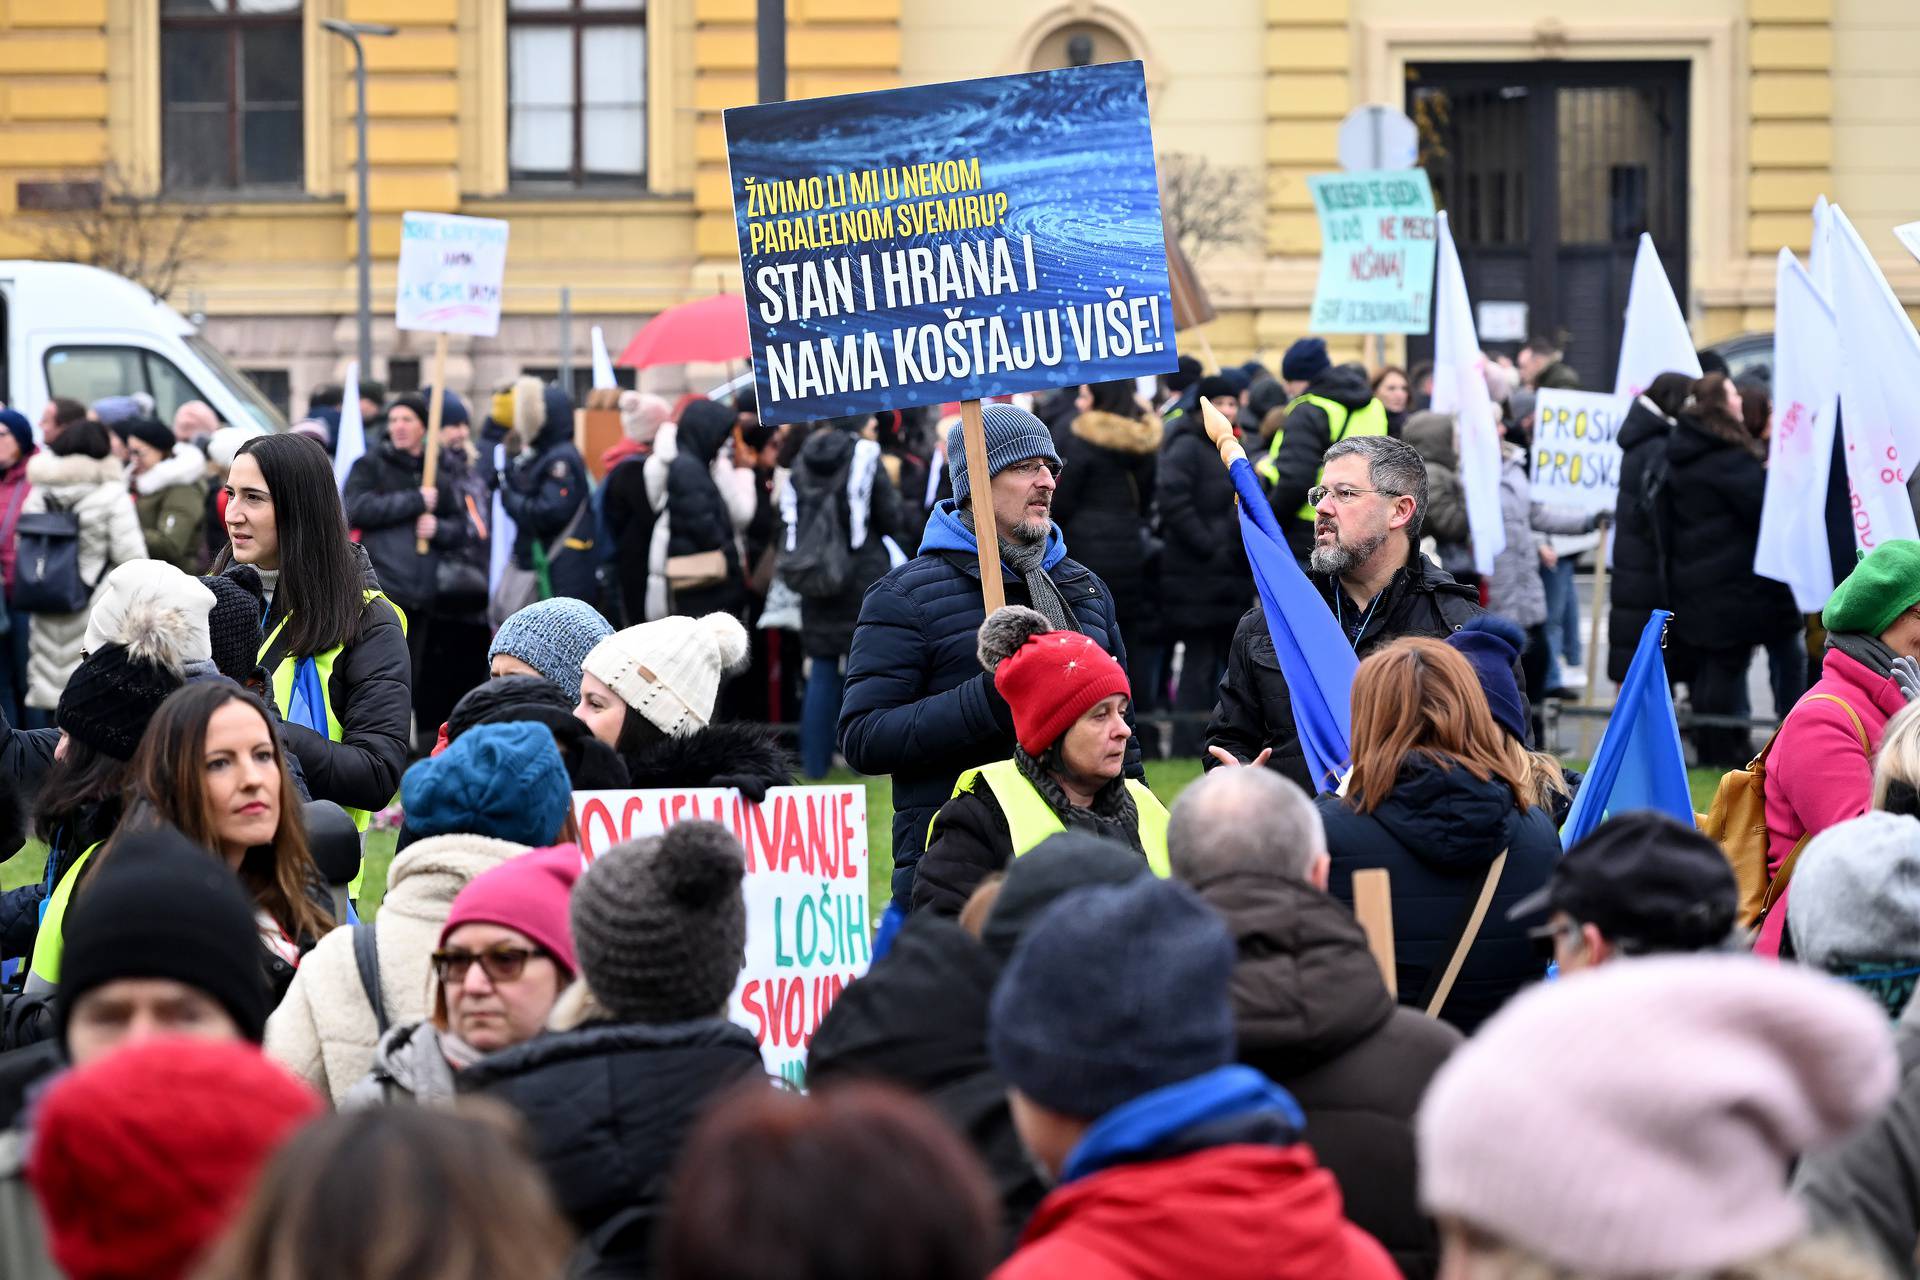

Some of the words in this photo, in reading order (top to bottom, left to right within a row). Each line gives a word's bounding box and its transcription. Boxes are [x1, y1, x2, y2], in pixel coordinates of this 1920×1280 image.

[744, 176, 823, 217] ŽIVIMO
[827, 174, 846, 207] LI
[850, 169, 879, 204] MI
[883, 167, 899, 200] U
[902, 157, 982, 198] NEKOM
[750, 206, 894, 255] PARALELNOM
[897, 191, 1008, 237] SVEMIRU?
[756, 257, 855, 324] STAN
[861, 254, 876, 311] I
[881, 236, 1019, 309] HRANA
[1022, 234, 1038, 291] I
[765, 331, 890, 402] NAMA
[893, 306, 1062, 386] KOŠTAJU
[1066, 286, 1164, 361] VIŠE!
[774, 883, 868, 967] LOŠIH
[741, 973, 856, 1049] SVOJI
